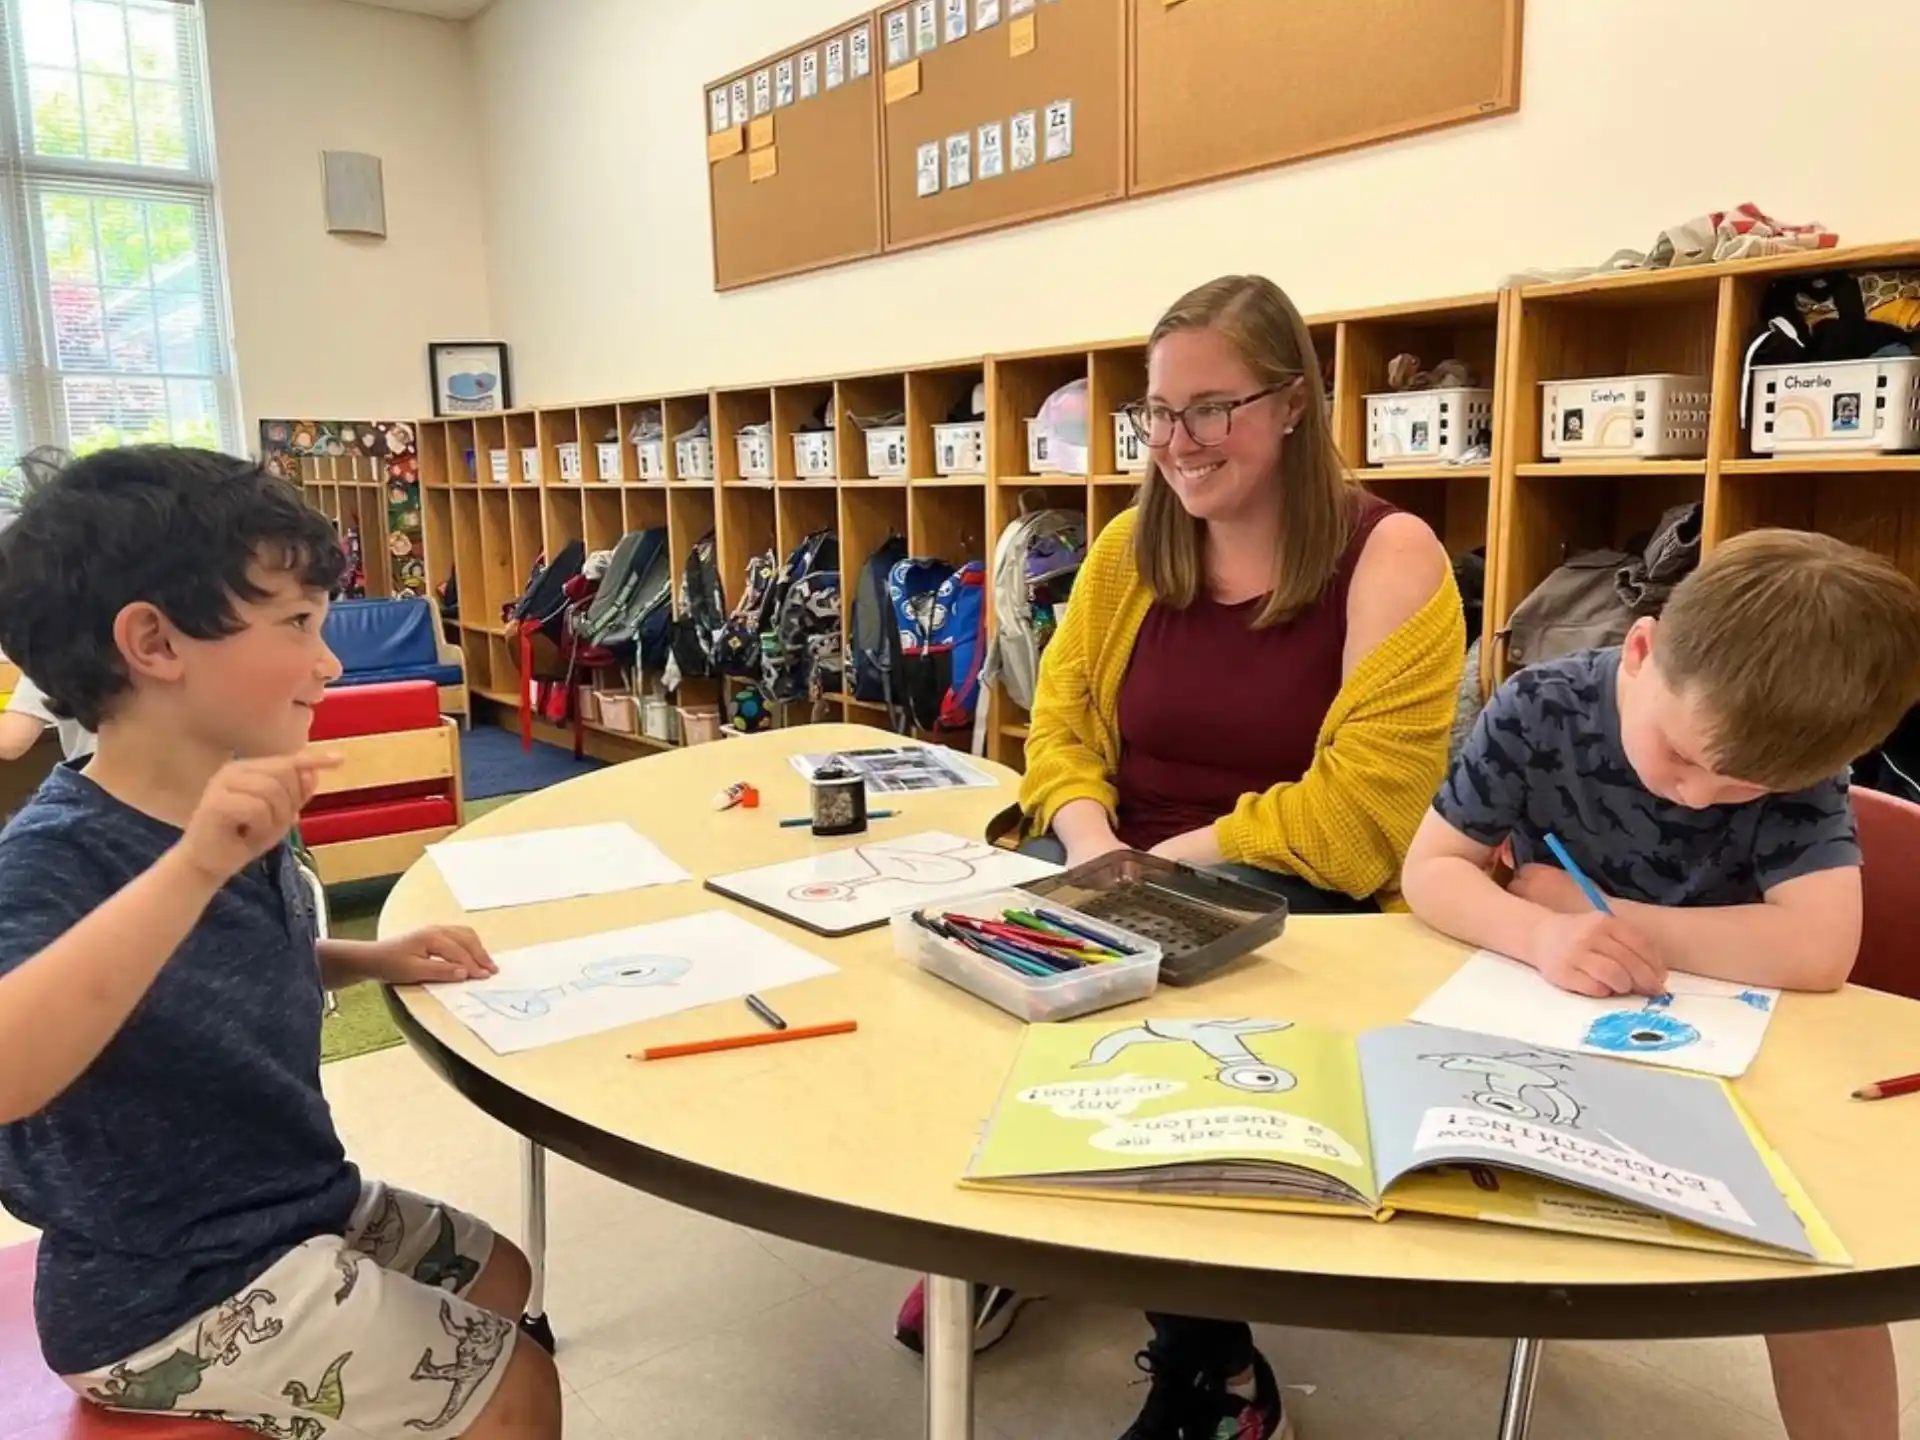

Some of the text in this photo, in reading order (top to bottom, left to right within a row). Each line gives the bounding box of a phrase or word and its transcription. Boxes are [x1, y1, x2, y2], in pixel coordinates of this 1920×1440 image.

[1051, 108, 1067, 127] Zz
[1784, 374, 1832, 389] Charlie
[1591, 389, 1626, 403] Evelyn
[1069, 1099, 1122, 1111] Any
[1437, 1130, 1518, 1149] know
[1536, 1146, 1683, 1197] already
